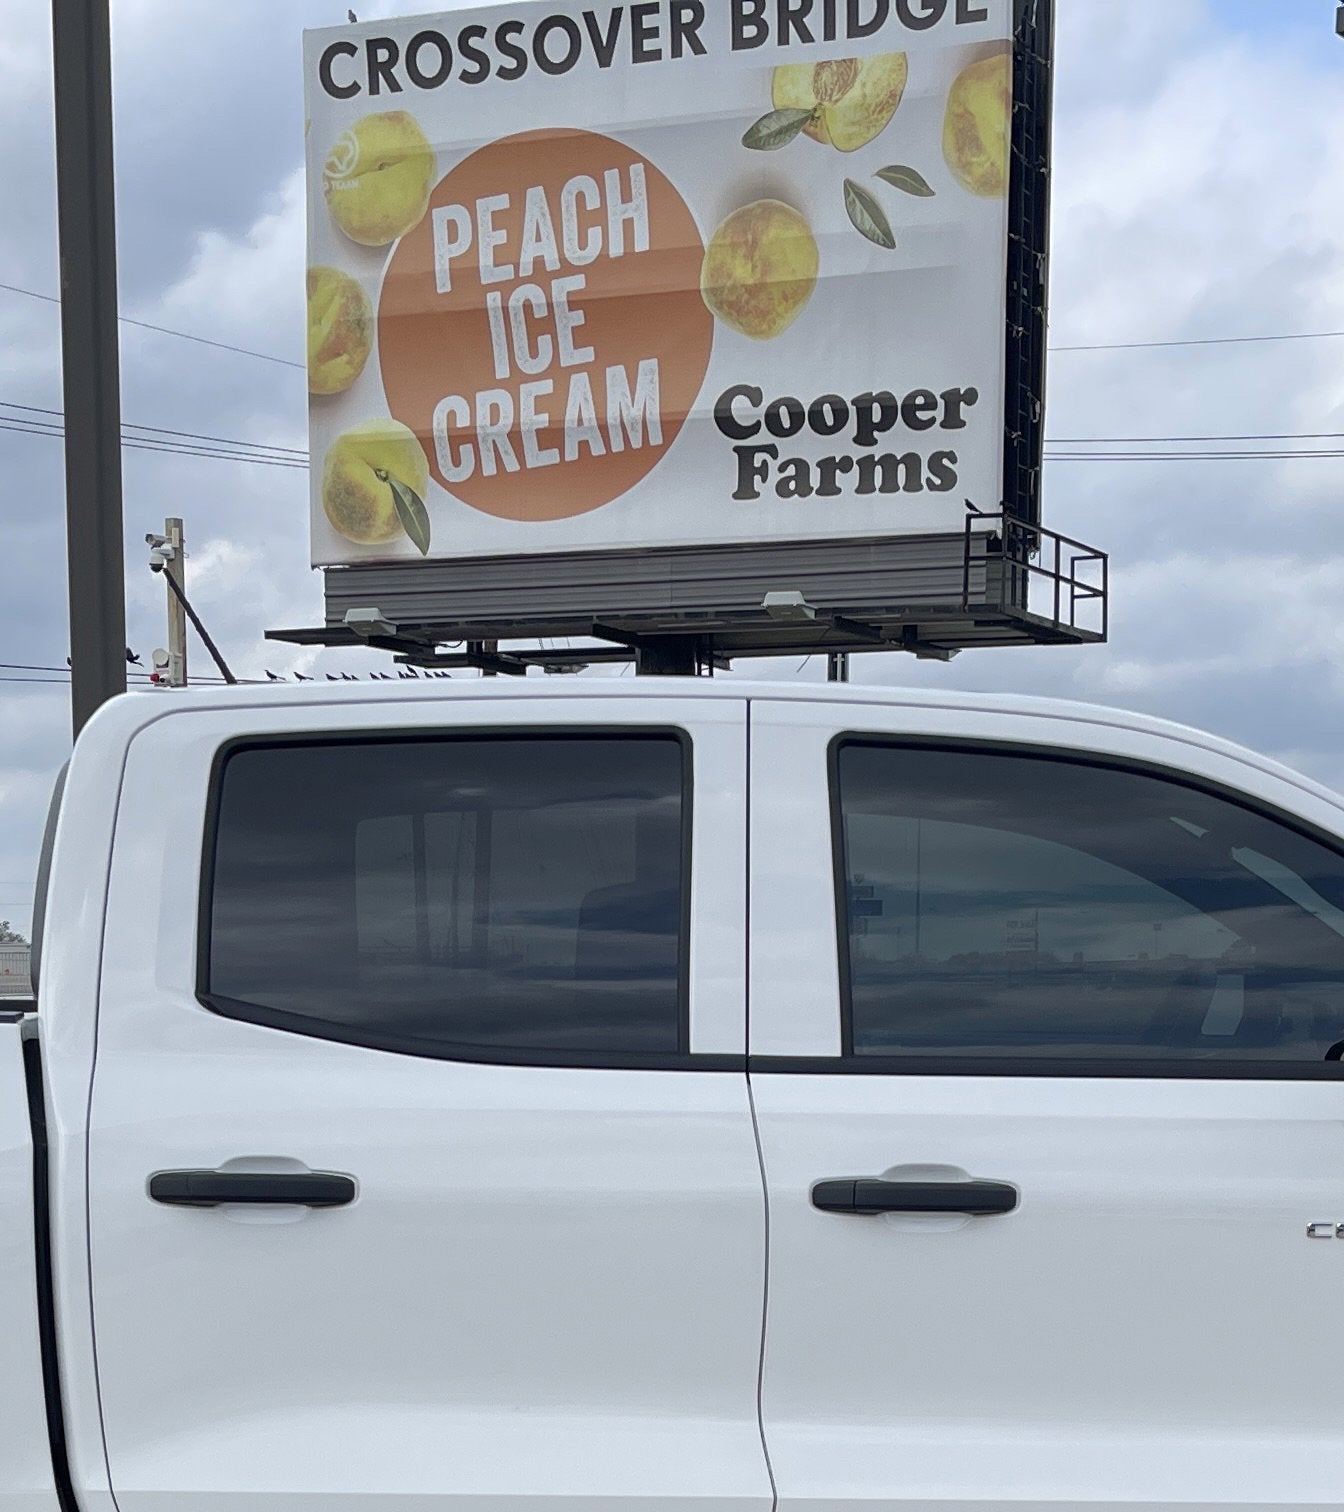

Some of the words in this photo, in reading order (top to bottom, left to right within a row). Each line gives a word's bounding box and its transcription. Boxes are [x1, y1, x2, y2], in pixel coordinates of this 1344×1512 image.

[318, 0, 707, 100] CROSSOVER
[431, 162, 650, 294] PEACH
[486, 273, 595, 380] ICE
[432, 357, 664, 483] CREAM
[713, 384, 979, 447] Cooper
[731, 443, 958, 500] Farms
